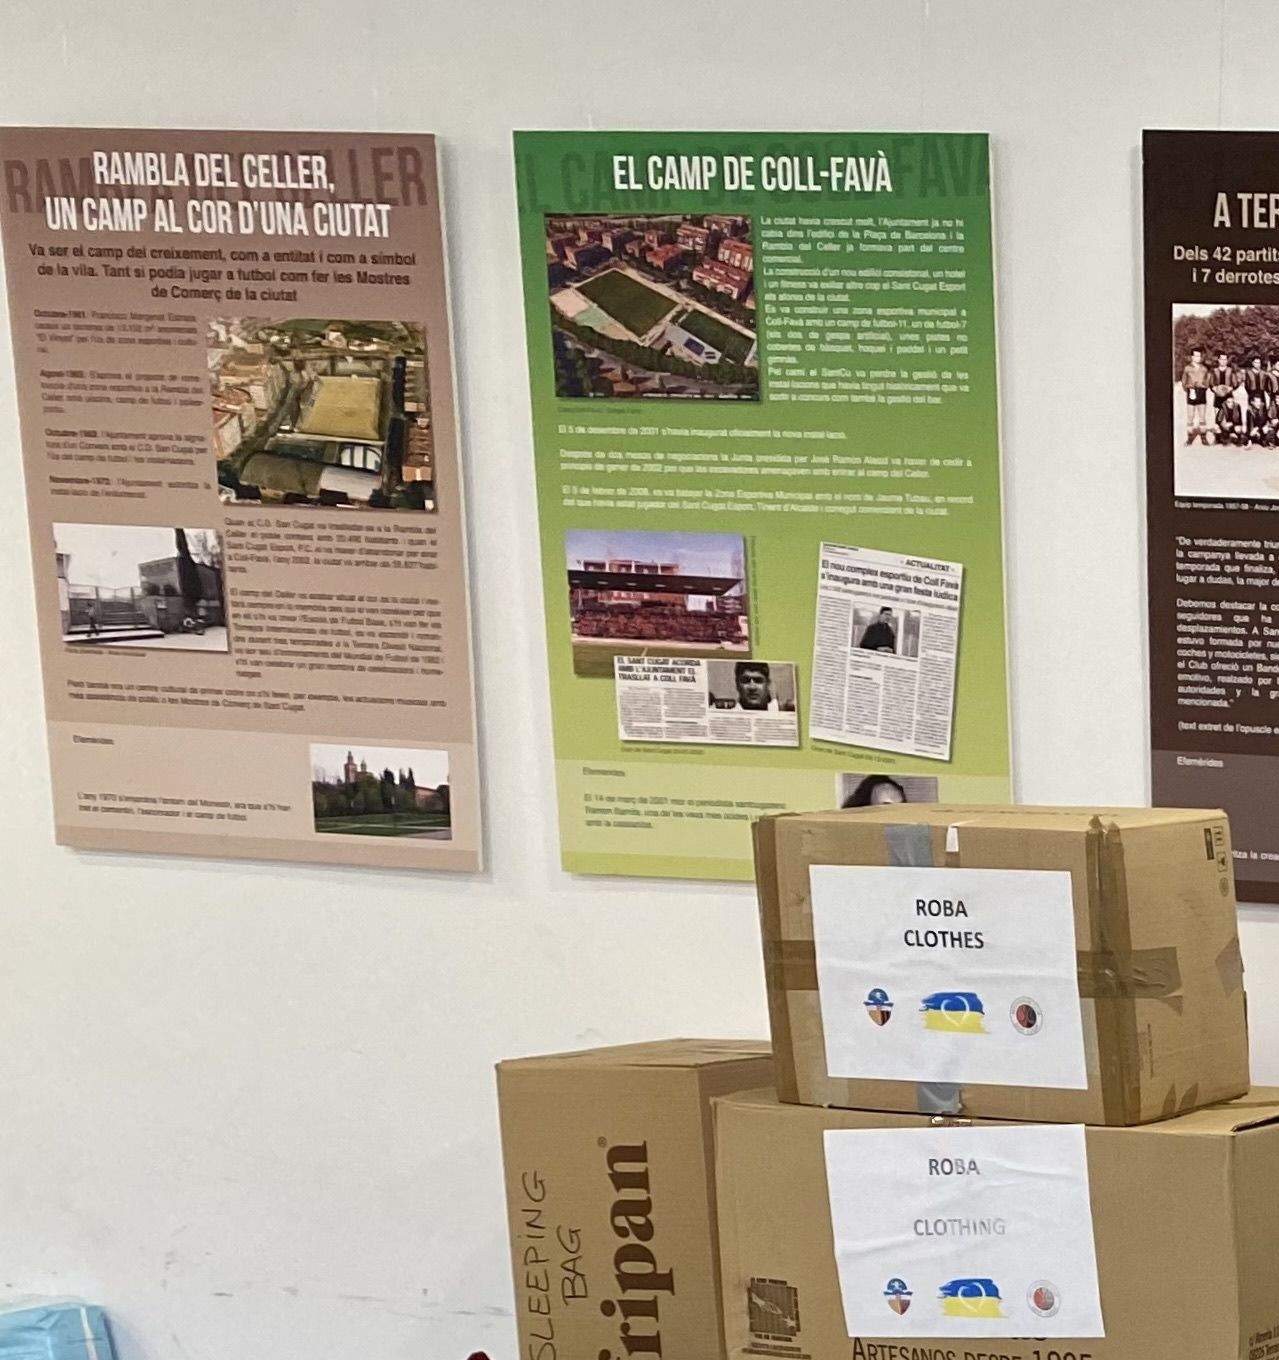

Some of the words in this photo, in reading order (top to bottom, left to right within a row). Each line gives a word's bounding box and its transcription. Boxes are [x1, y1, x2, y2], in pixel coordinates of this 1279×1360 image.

[93, 152, 189, 187] RAMBLA
[194, 156, 239, 188] DEL
[244, 154, 335, 192] CELLER,
[613, 156, 642, 190] EL
[648, 156, 716, 191] CAMP
[723, 156, 754, 190] DE
[761, 149, 892, 192] COLL-FAVÀ
[45, 196, 78, 230] UN
[83, 198, 147, 232] CAMP
[154, 200, 183, 232] AL
[188, 200, 233, 234] COR
[313, 203, 390, 238] CIUTAT
[1214, 193, 1231, 228] A
[1174, 246, 1209, 263] Dels
[1213, 247, 1231, 263] 42
[916, 899, 968, 917] ROBA
[904, 930, 984, 949] CLOTHES
[929, 1159, 980, 1175] ROBA
[913, 1219, 1005, 1237] CLOTHING
[556, 1226, 587, 1304] BAG
